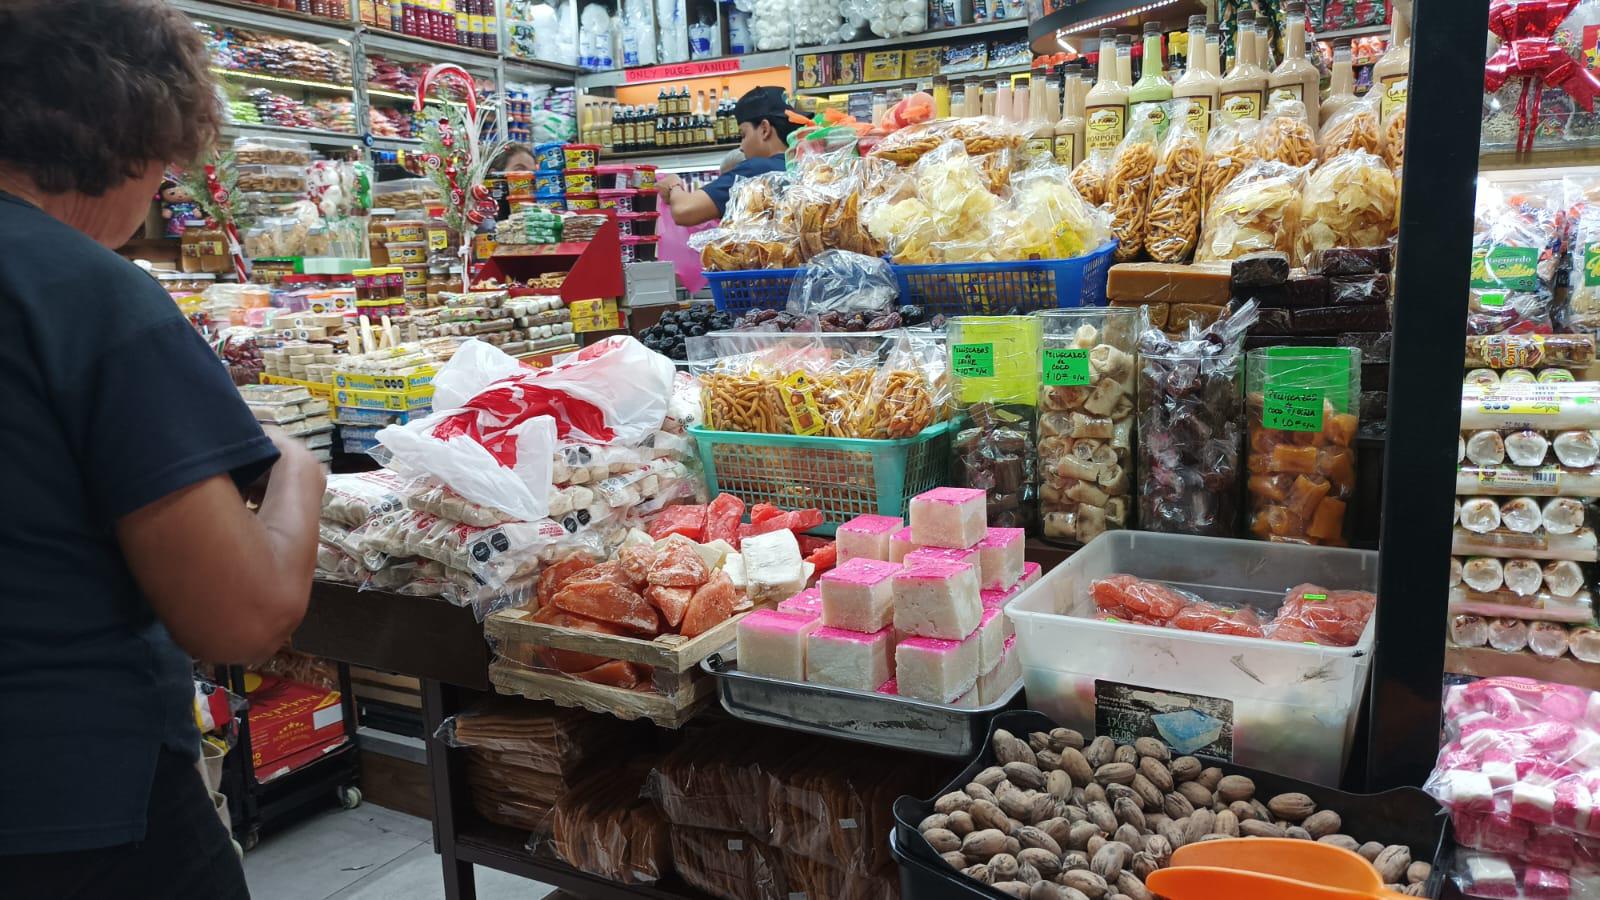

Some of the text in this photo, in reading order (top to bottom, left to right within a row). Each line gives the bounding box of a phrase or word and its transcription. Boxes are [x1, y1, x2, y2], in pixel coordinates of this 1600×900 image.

[630, 62, 740, 80] ONLY PURE VANILLA
